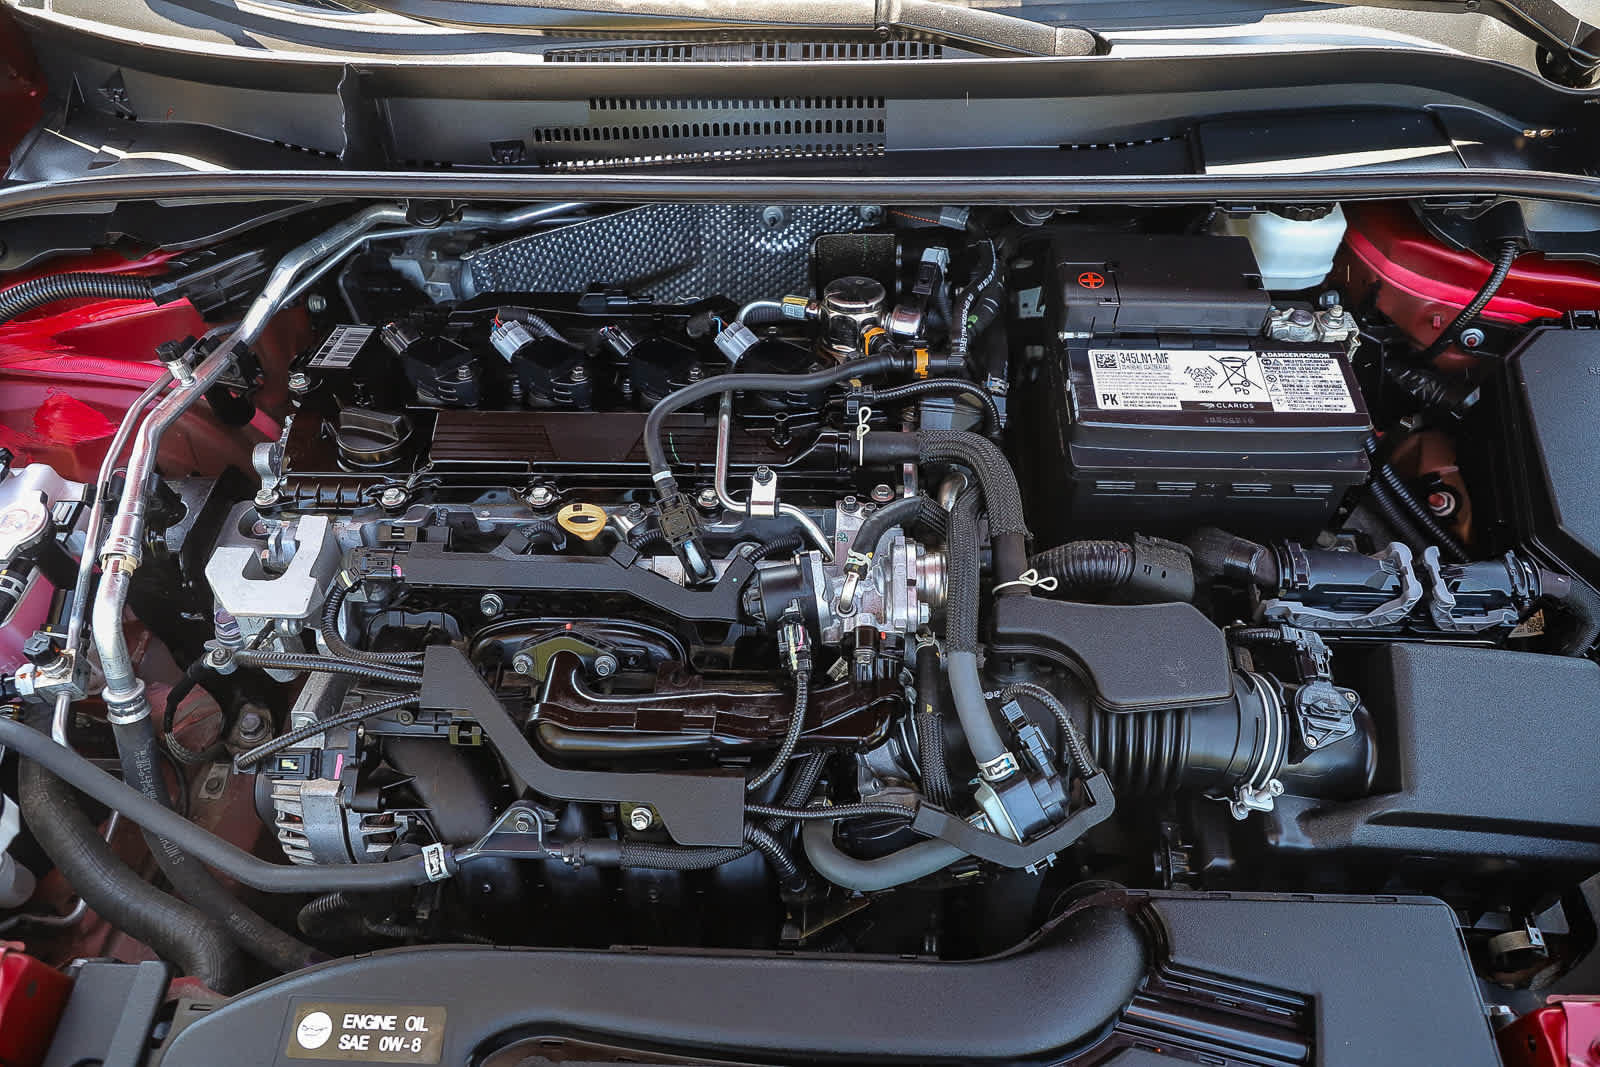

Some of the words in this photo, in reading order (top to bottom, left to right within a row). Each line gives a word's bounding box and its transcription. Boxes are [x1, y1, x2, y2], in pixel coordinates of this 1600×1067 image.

[1120, 352, 1169, 364] 345LN1-MF
[1234, 386, 1250, 395] Pb
[1102, 393, 1119, 406] PK
[342, 1013, 398, 1031] ENGINE
[404, 1015, 429, 1032] OIL
[338, 1034, 370, 1051] SAE
[378, 1036, 422, 1053] 0W-8
